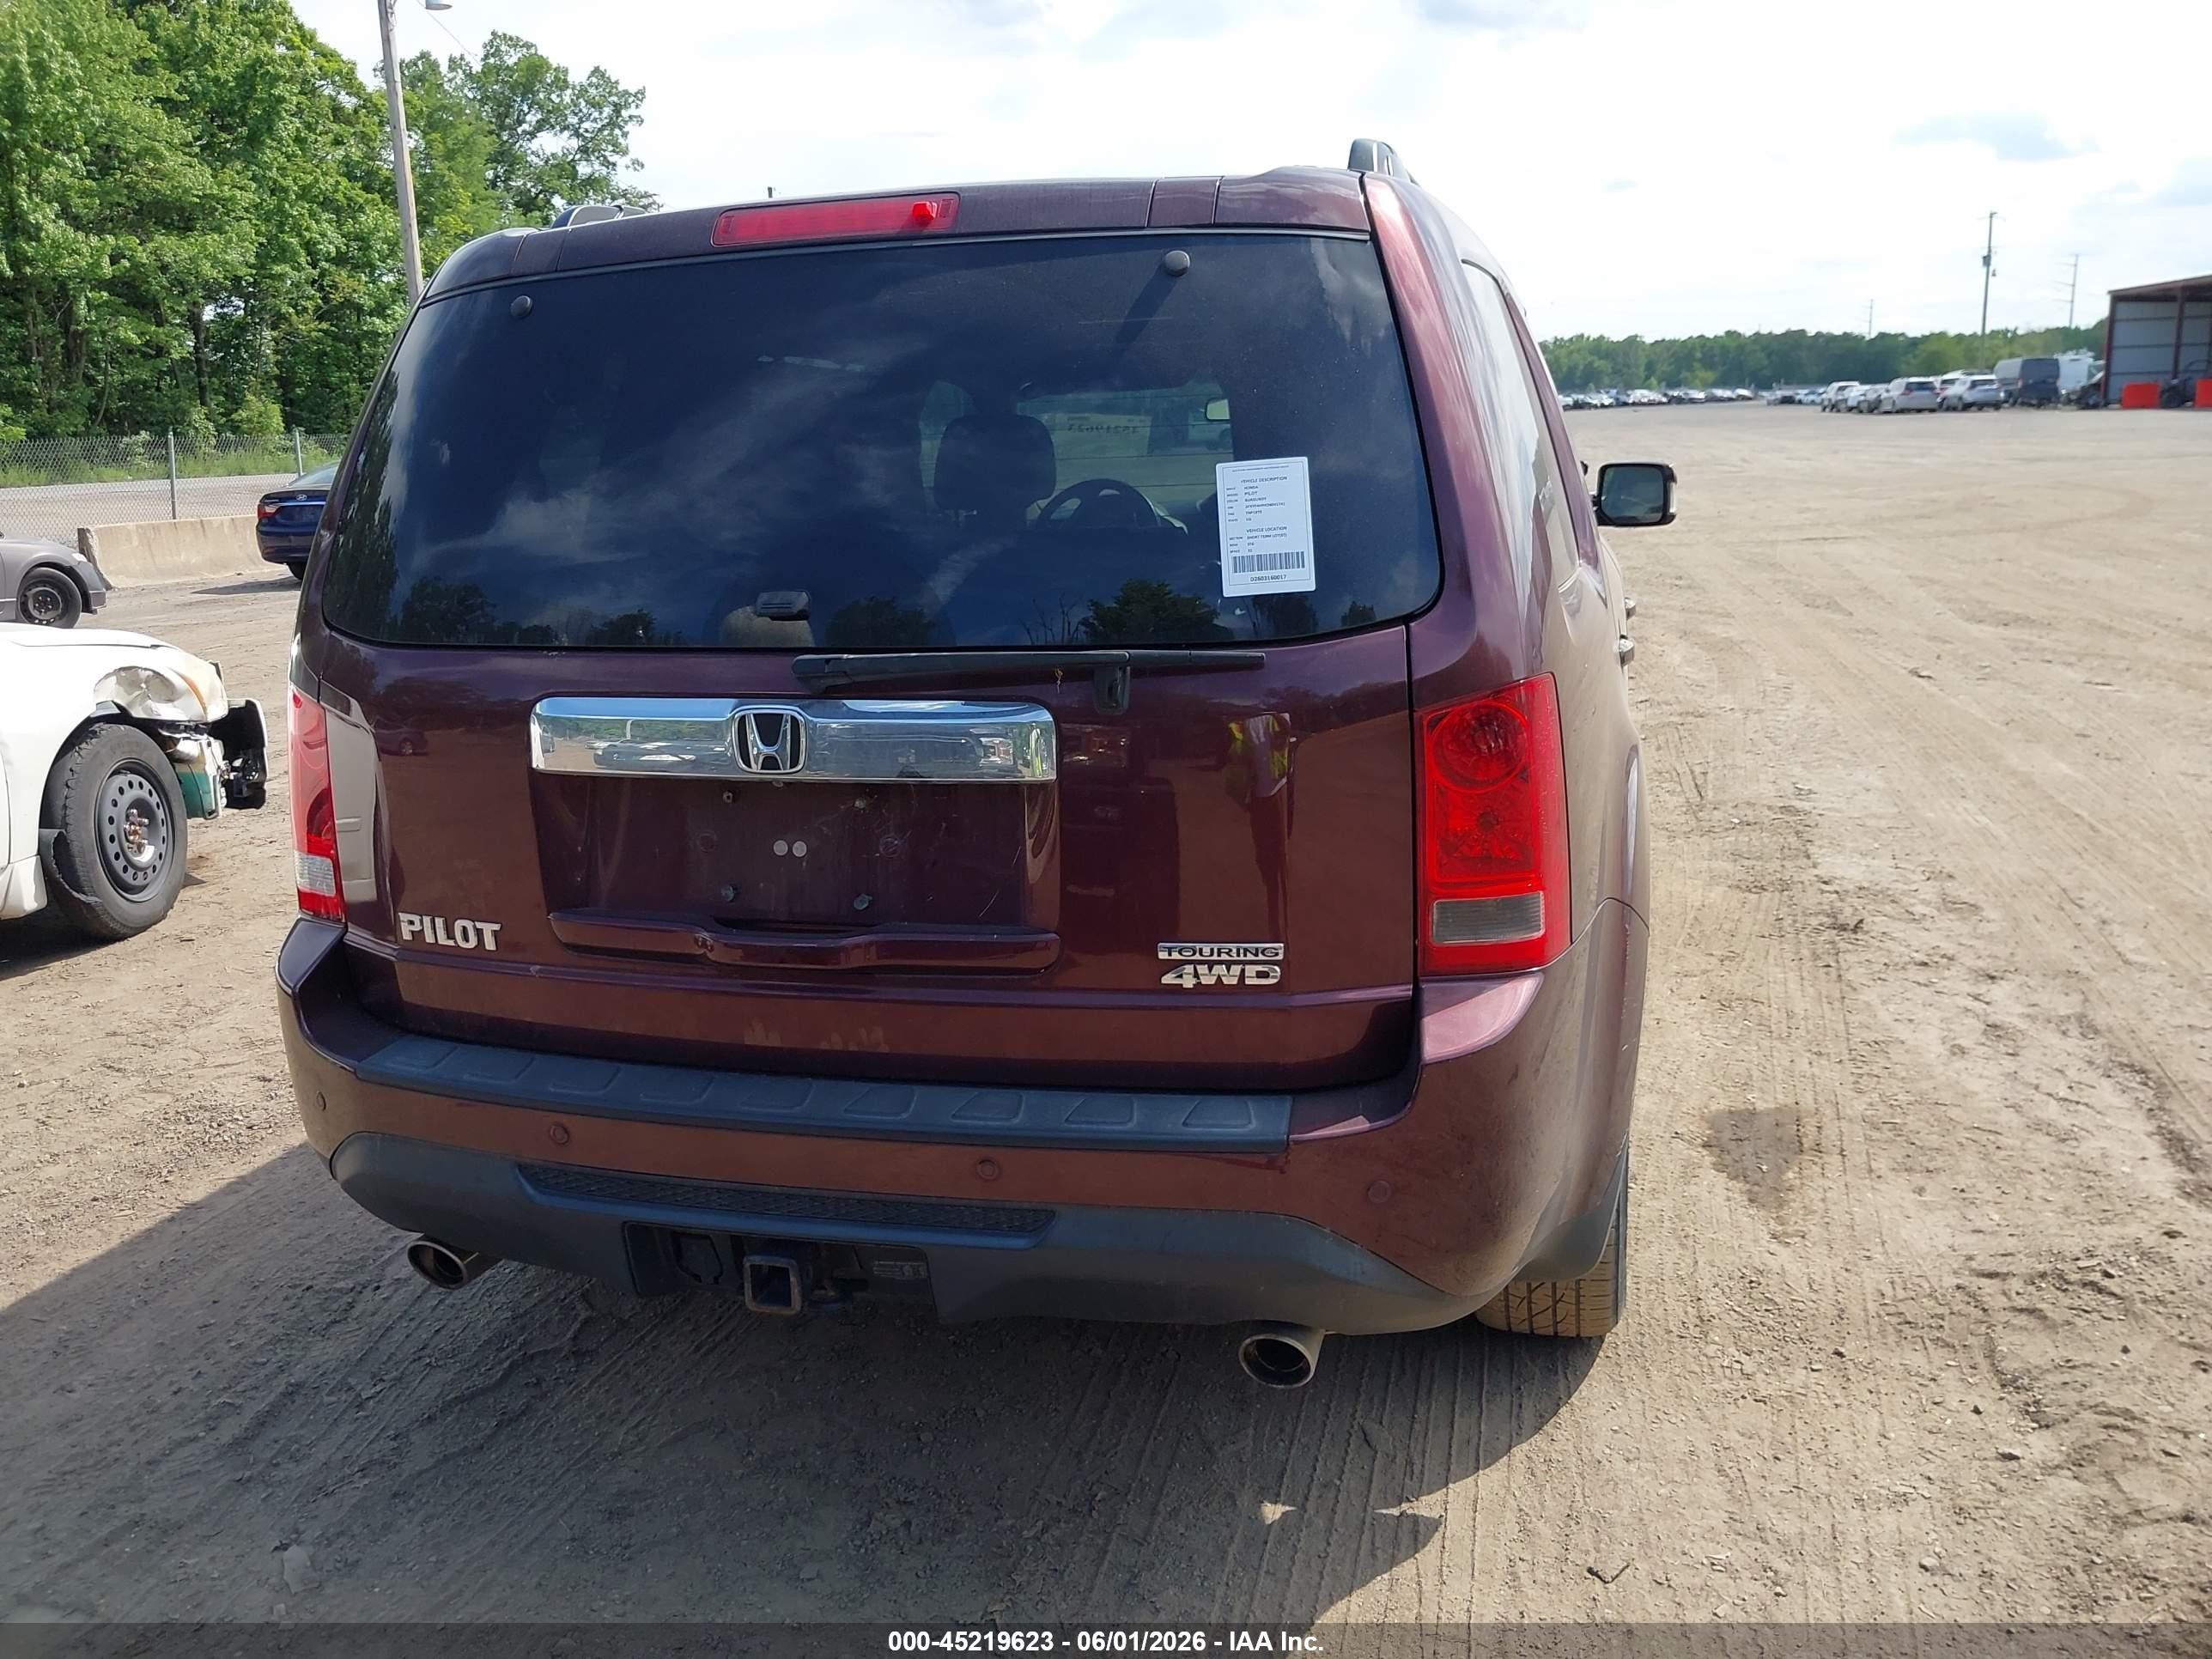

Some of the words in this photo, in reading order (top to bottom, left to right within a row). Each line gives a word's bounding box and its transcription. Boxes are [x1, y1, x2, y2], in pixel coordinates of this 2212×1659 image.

[398, 912, 501, 951] PILOT
[1161, 945, 1281, 958] TOURING
[1160, 963, 1282, 988] 4WD
